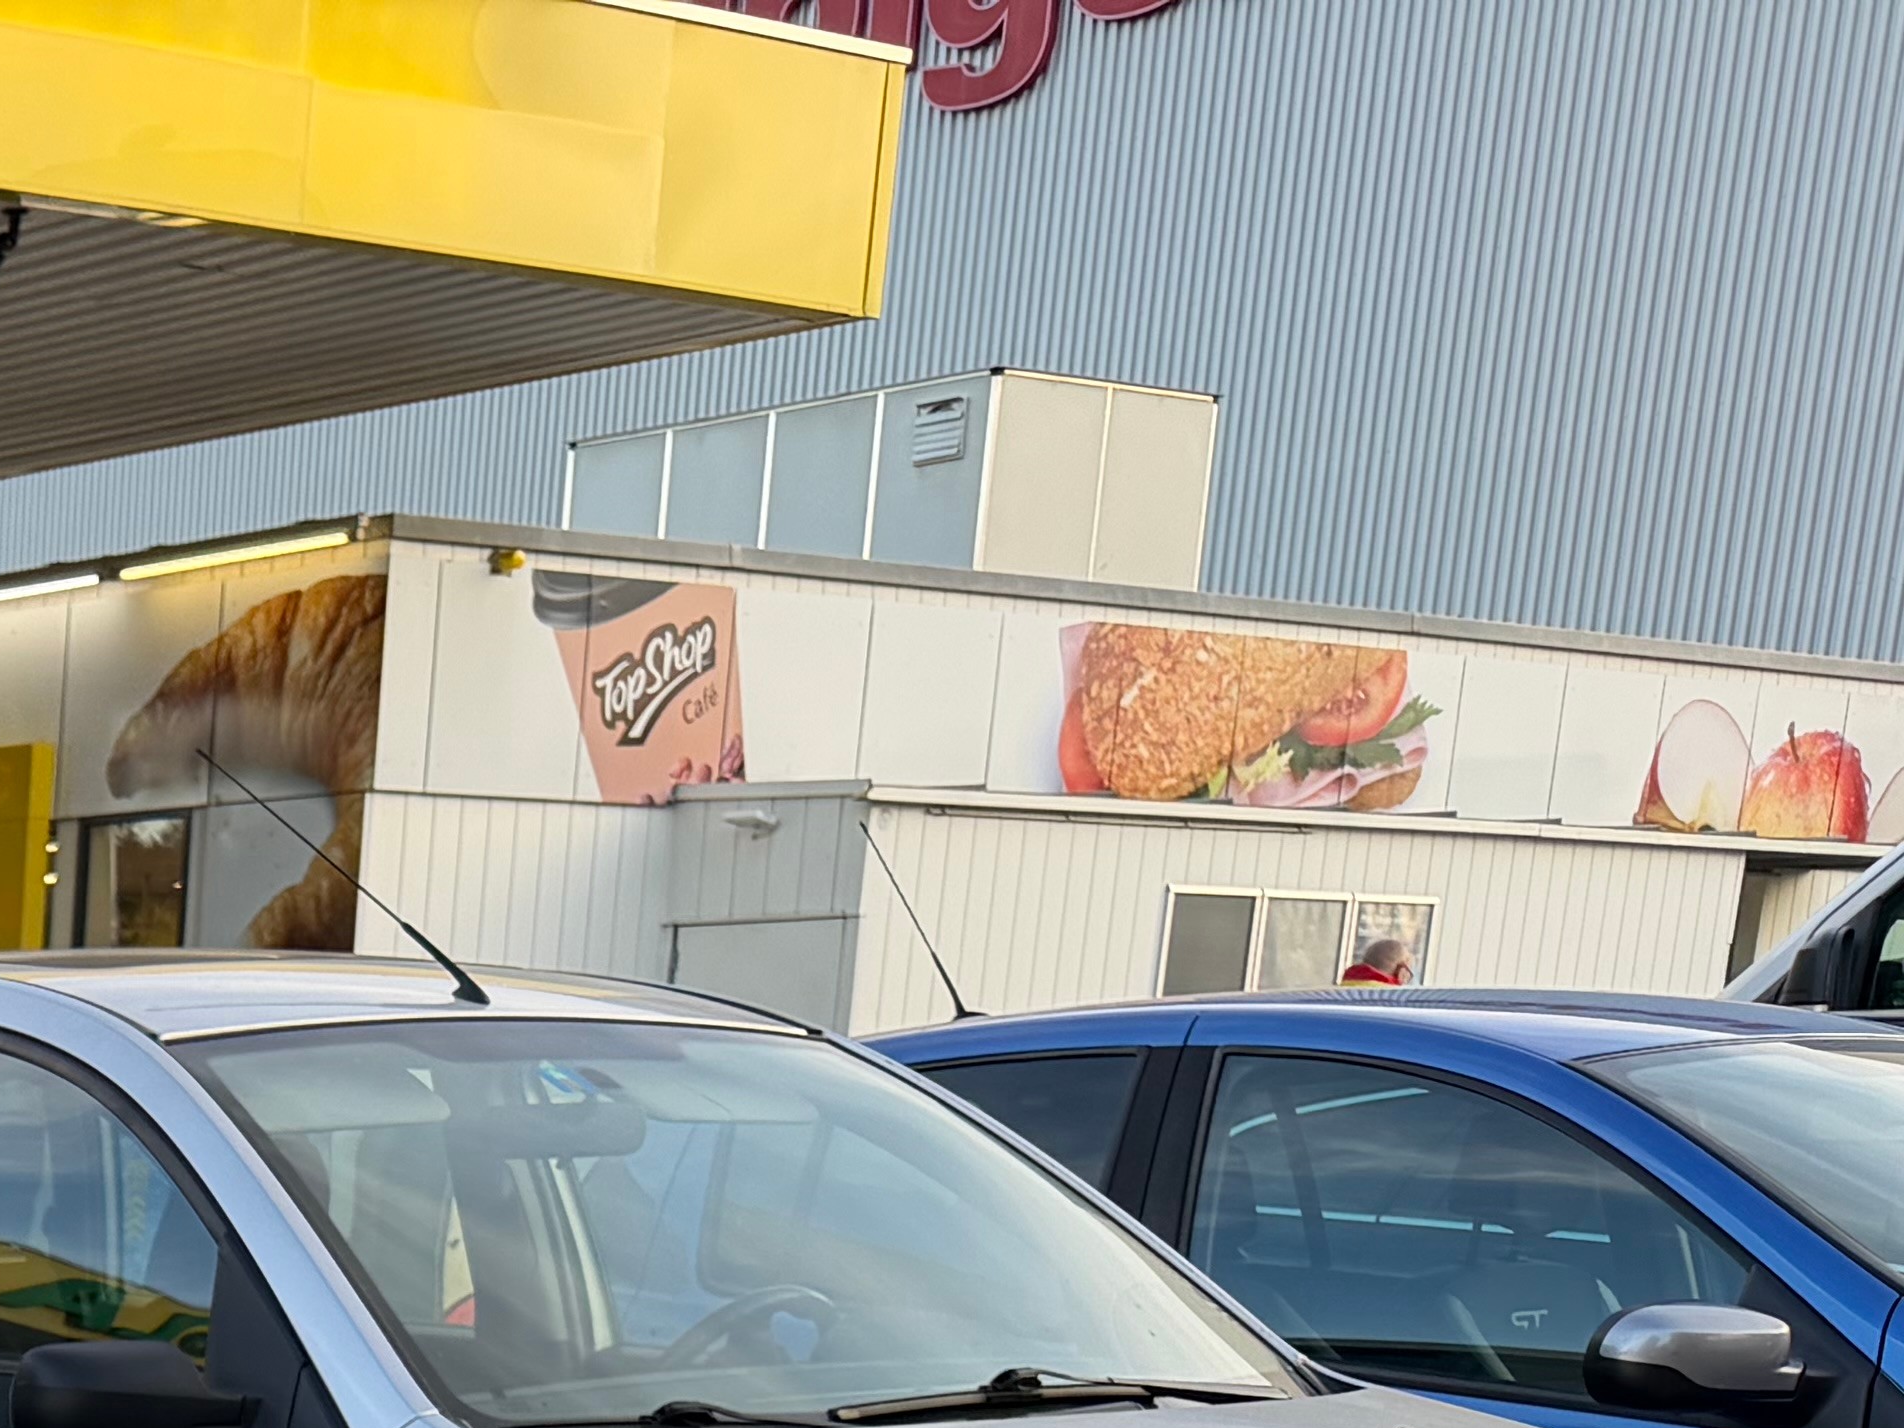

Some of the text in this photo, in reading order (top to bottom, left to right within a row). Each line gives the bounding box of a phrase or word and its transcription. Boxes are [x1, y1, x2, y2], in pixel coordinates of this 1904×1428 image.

[594, 622, 714, 722] TopShop
[682, 681, 720, 725] Café
[1511, 1308, 1549, 1331] GT
